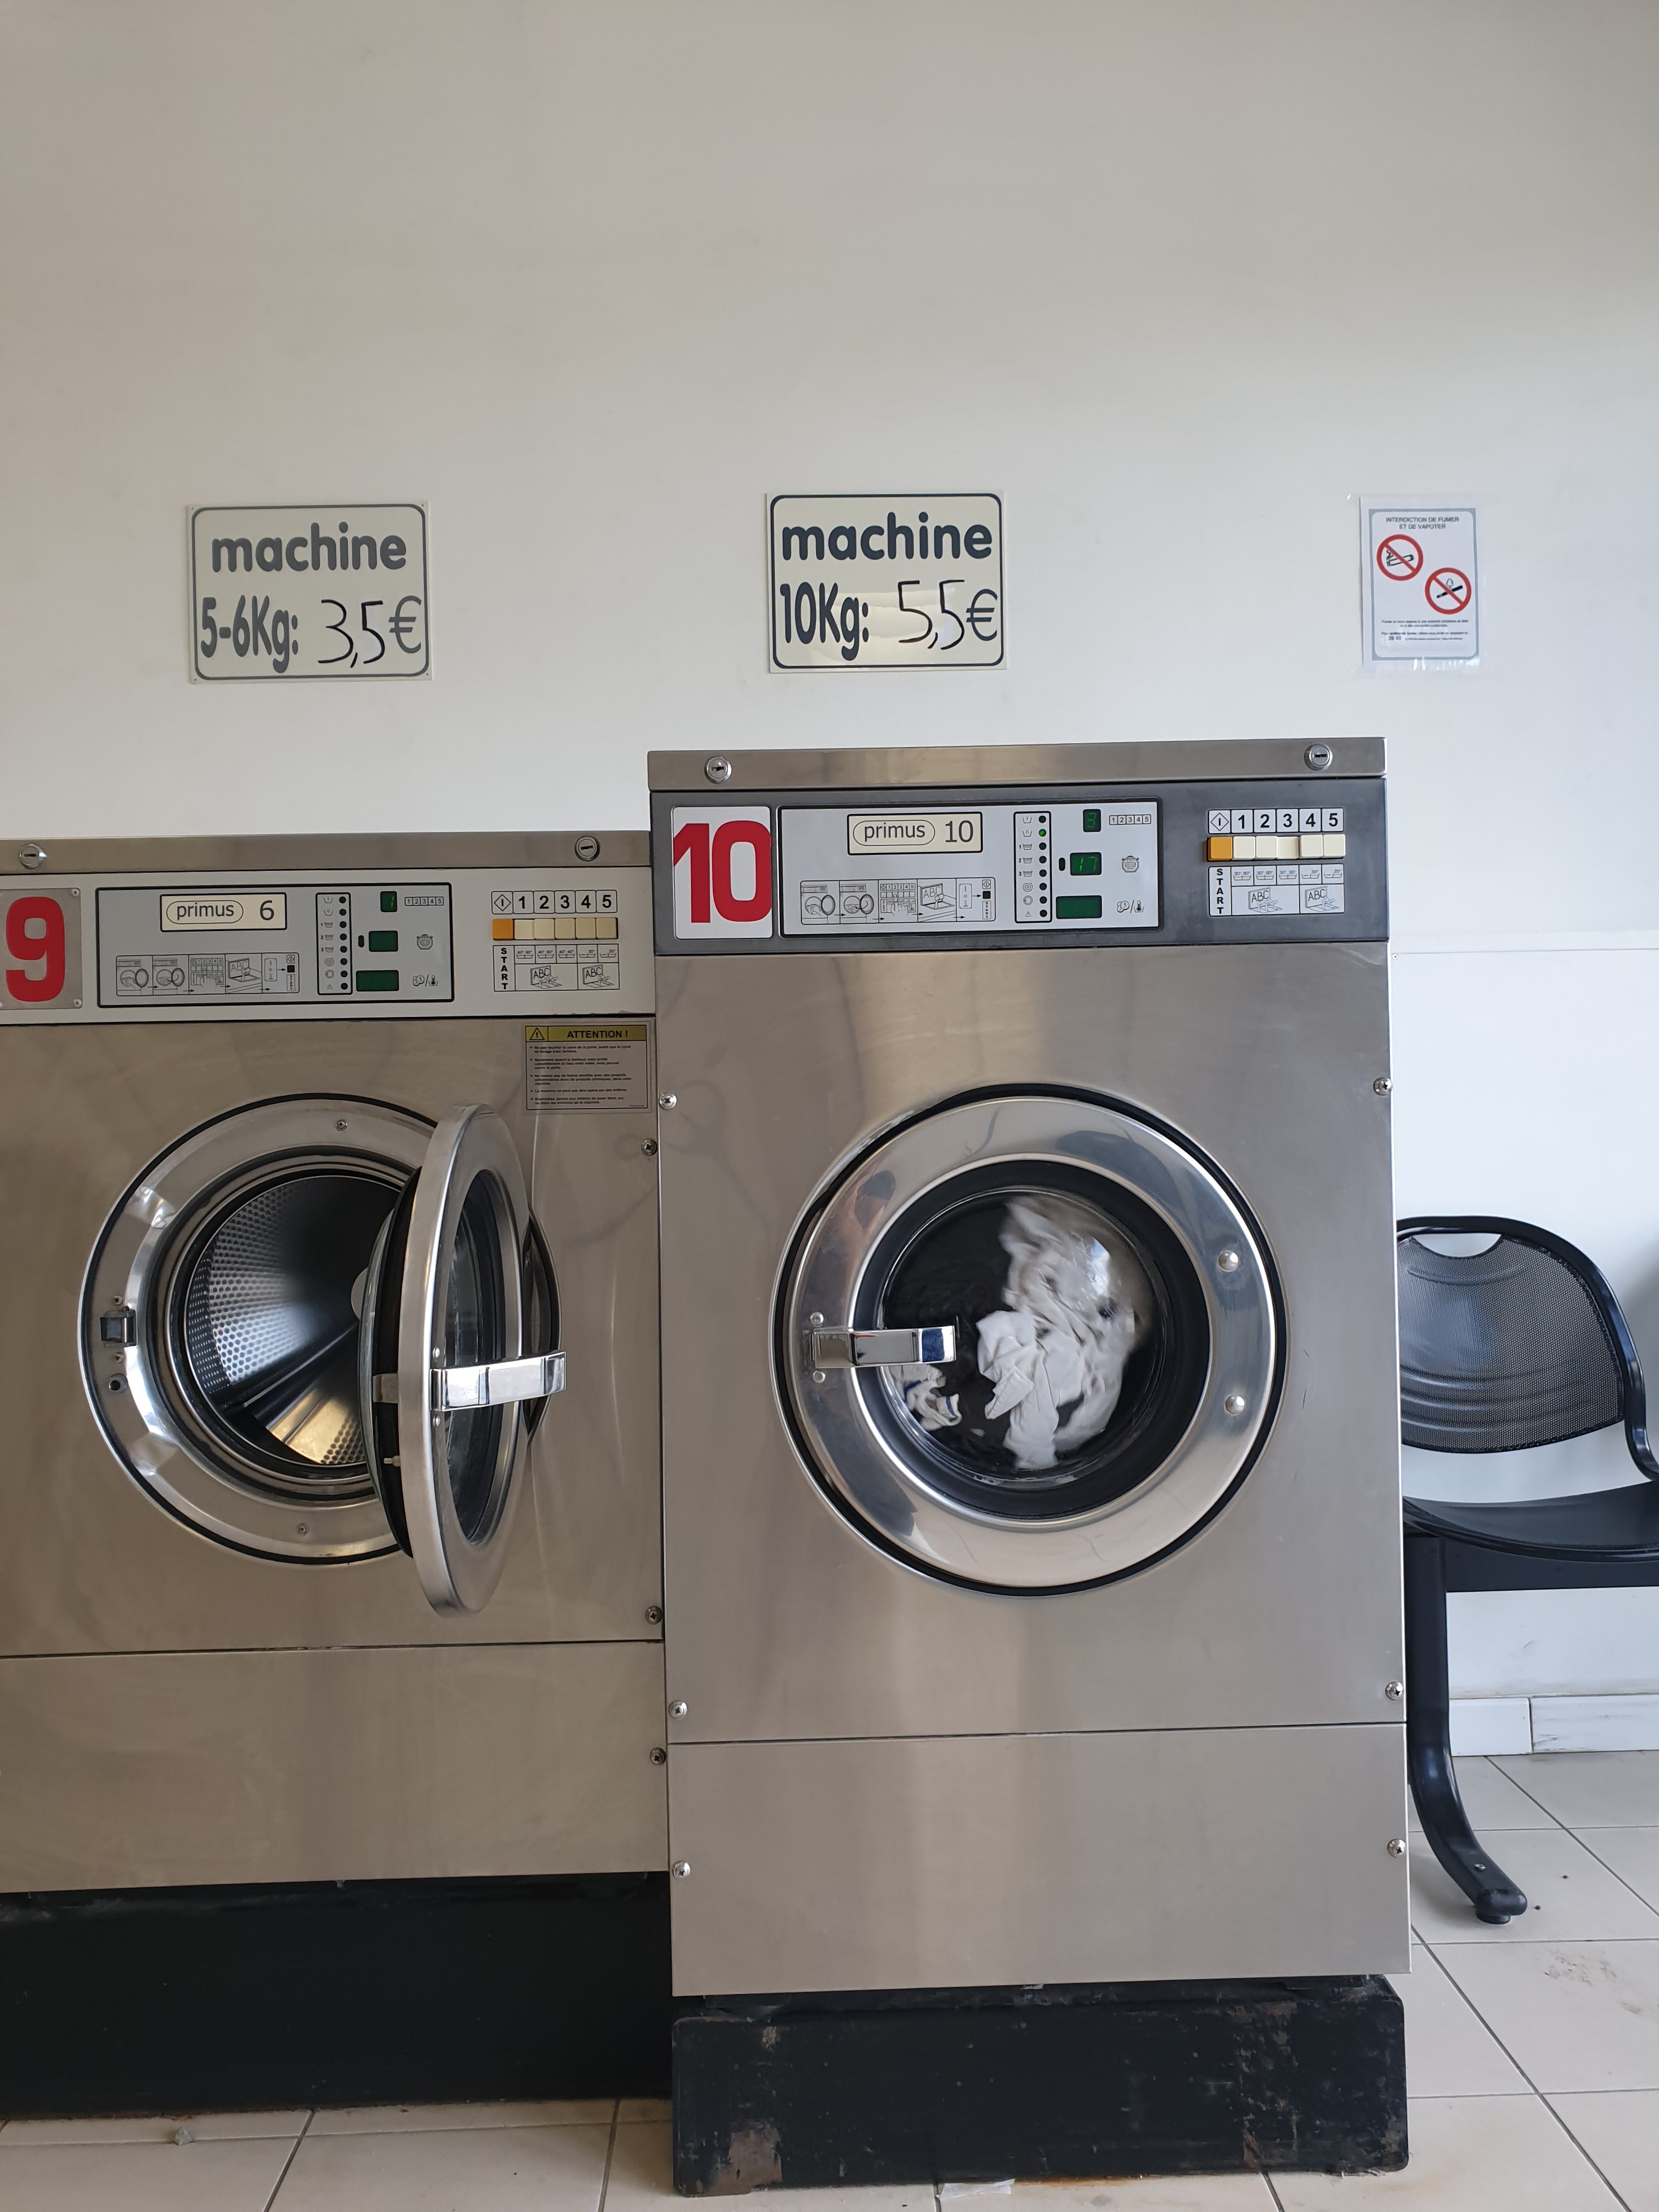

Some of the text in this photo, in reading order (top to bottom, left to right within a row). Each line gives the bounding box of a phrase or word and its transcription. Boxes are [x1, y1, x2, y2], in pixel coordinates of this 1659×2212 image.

[782, 512, 992, 561] machine
[212, 522, 407, 572] machine
[780, 582, 869, 661] 10Kg:
[201, 595, 298, 674] 5-6Kg:
[1238, 812, 1338, 829] 1 2 3 4 5
[864, 820, 974, 843] primus 10
[673, 820, 772, 923] 10
[1079, 855, 1098, 871] 17
[518, 894, 612, 909] 1 2 3 4 5
[1251, 890, 1269, 903] ABC
[1308, 889, 1326, 902] ABC
[177, 900, 275, 921] primus 6
[5, 896, 65, 1002] 9
[533, 968, 550, 979] ABC
[585, 967, 602, 979] ABC
[567, 1030, 623, 1039] ATTENTION
